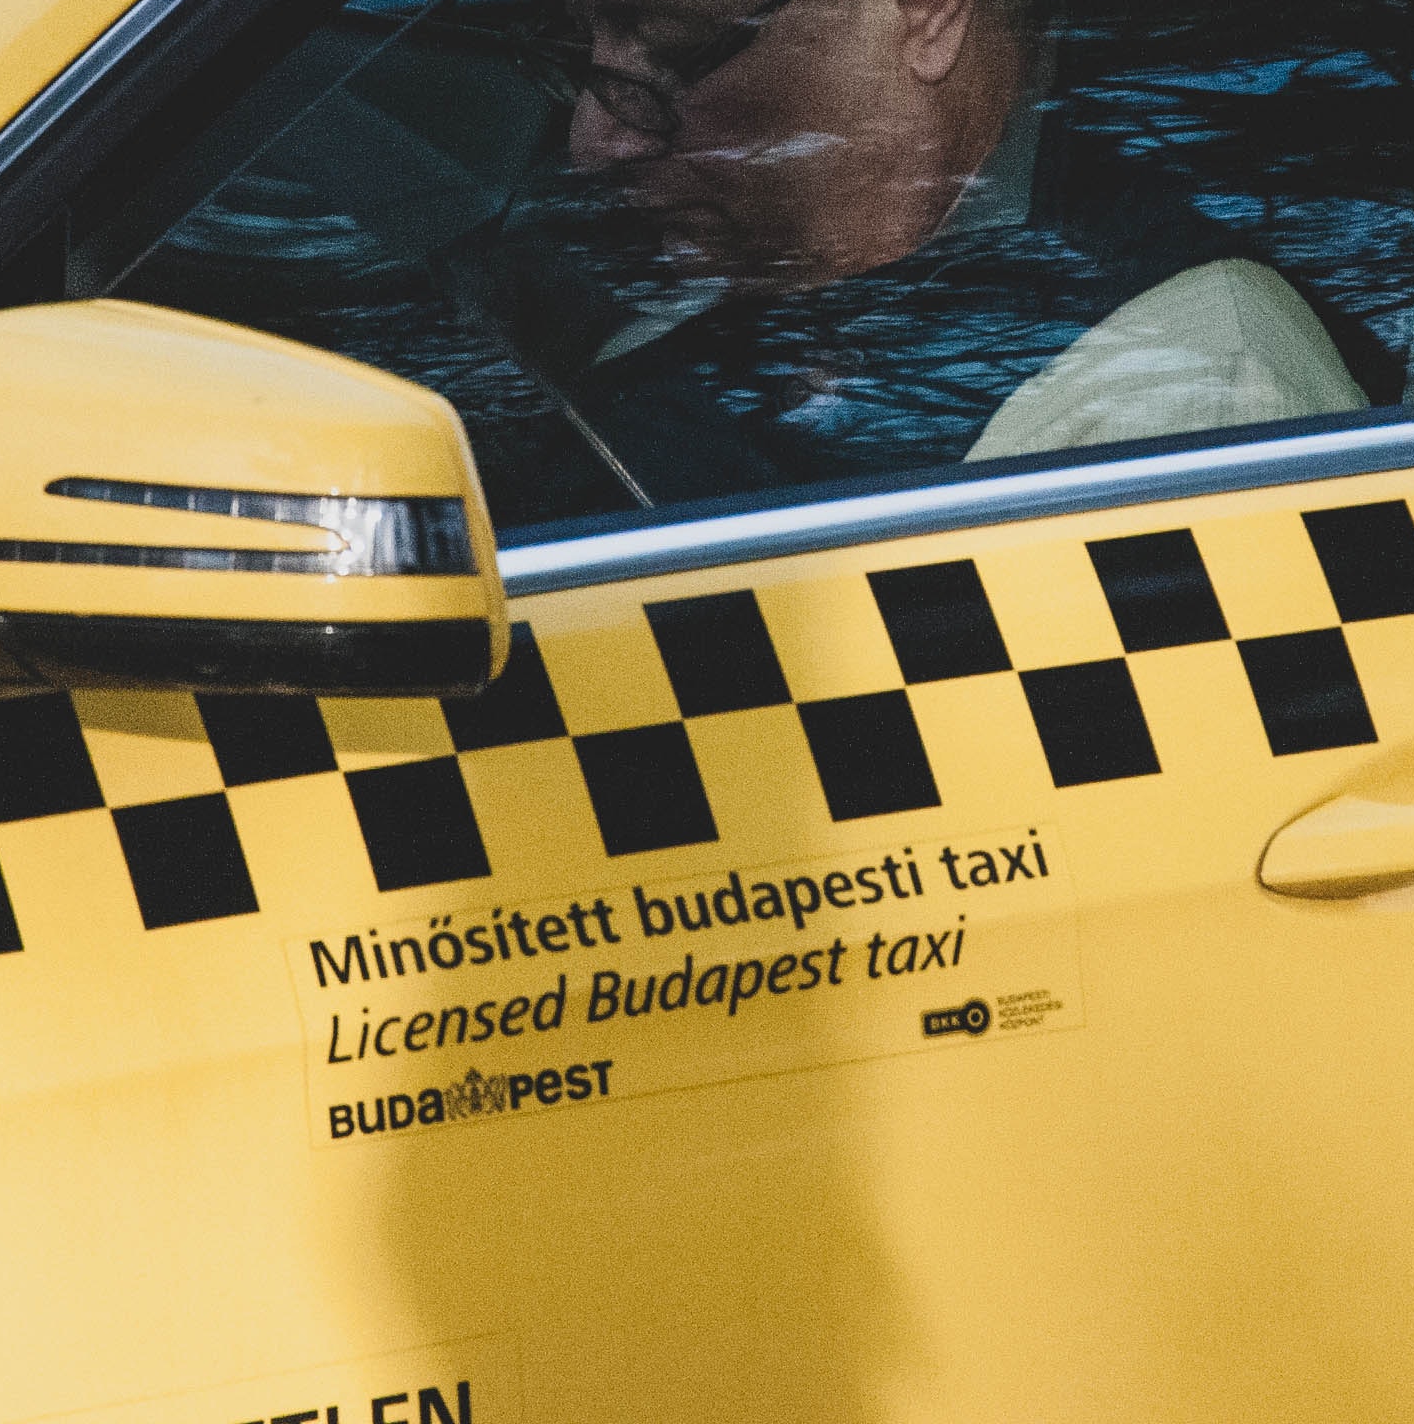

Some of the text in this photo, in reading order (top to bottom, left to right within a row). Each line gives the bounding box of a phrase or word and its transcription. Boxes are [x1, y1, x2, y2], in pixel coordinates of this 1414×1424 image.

[309, 828, 1050, 988] Minősített budapesti taxi
[327, 914, 967, 1065] Licensed Budapest taxi
